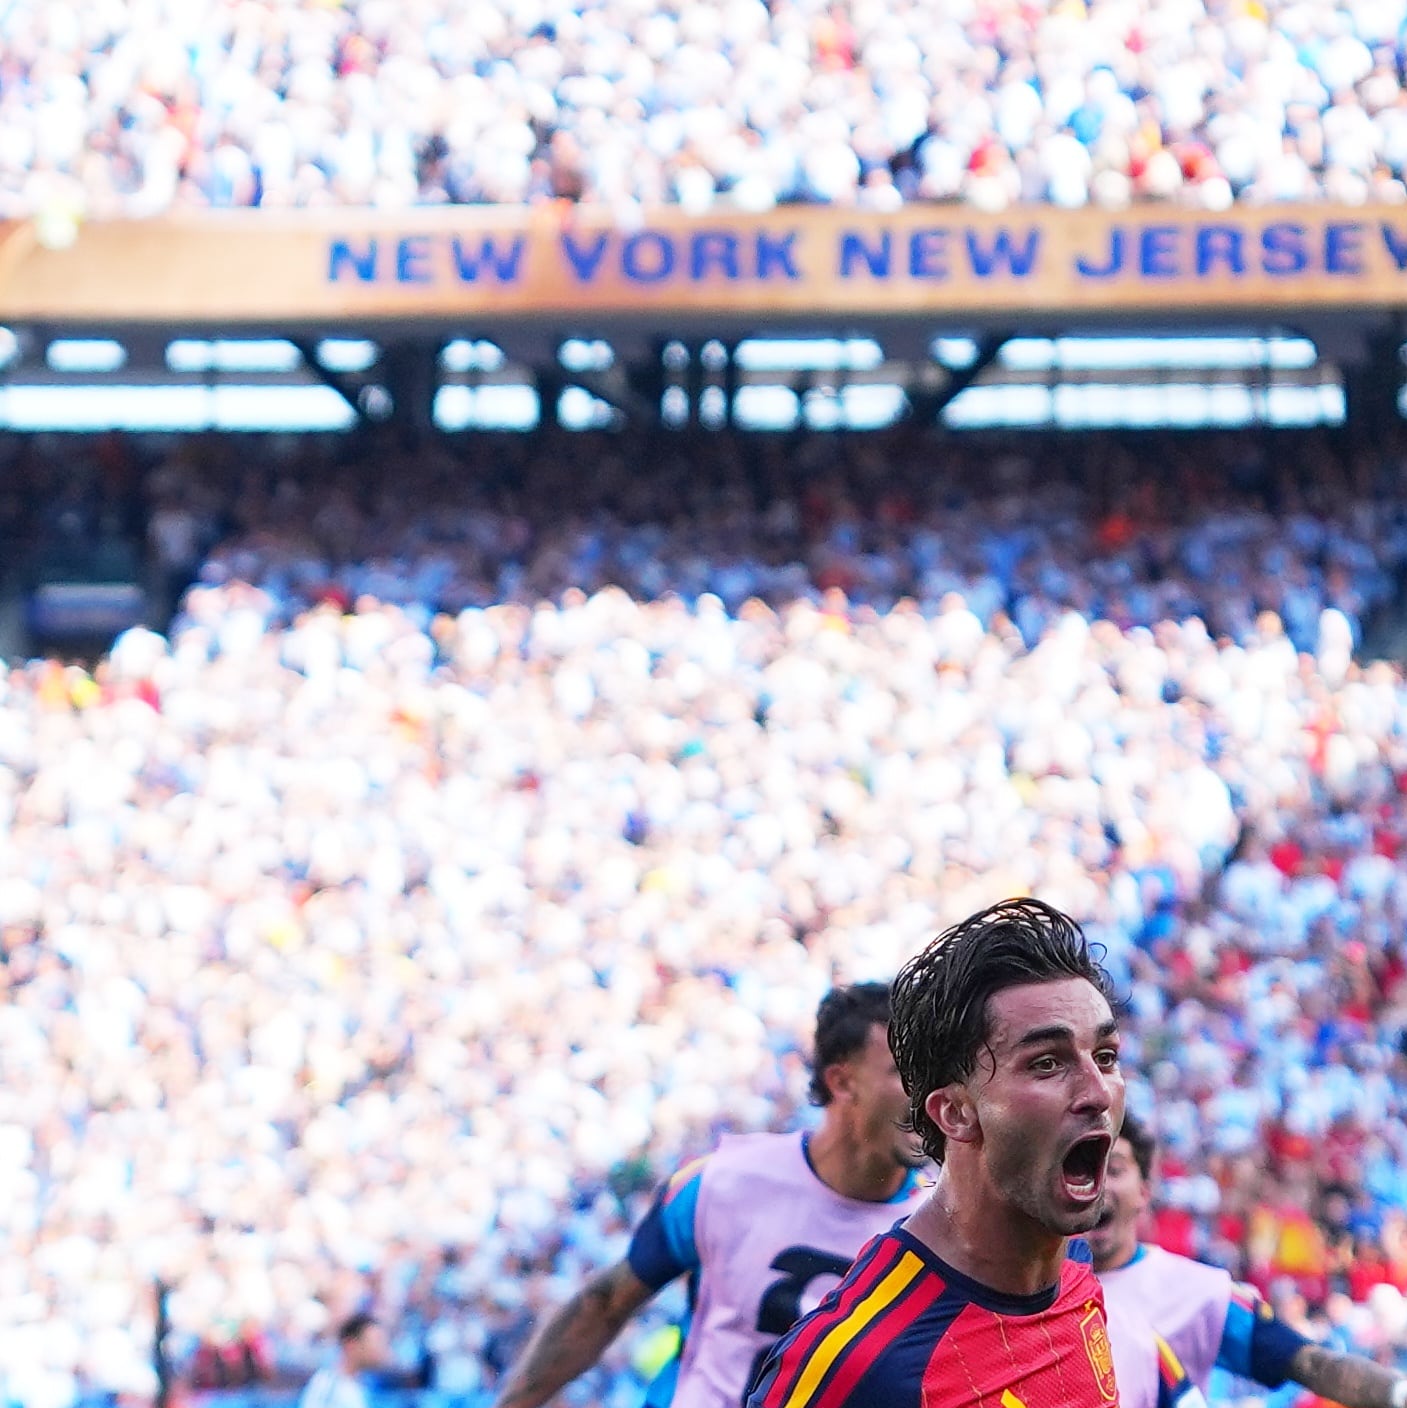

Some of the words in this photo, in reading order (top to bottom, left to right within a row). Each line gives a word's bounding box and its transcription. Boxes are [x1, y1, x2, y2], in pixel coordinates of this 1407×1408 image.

[324, 232, 527, 288] NEW
[558, 228, 803, 286] YORK
[834, 226, 1044, 284] NEW
